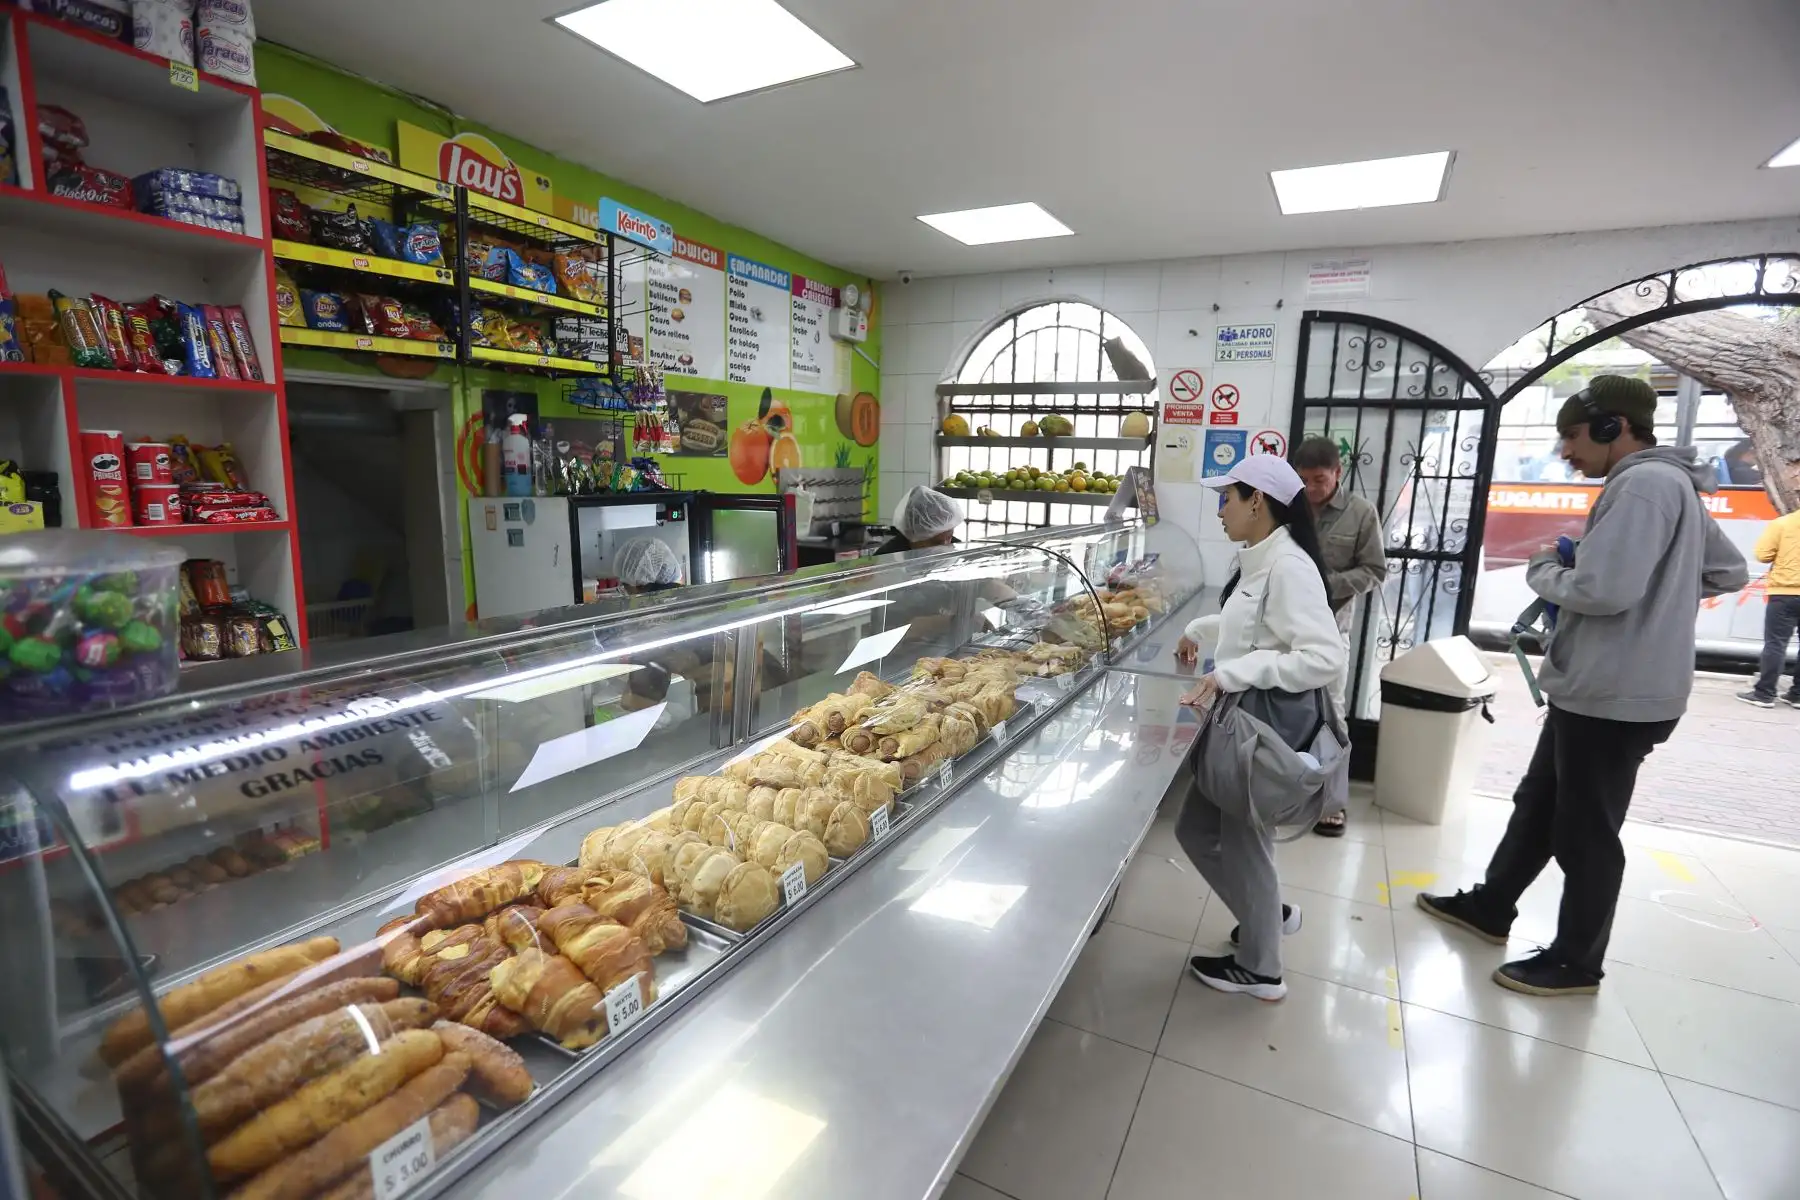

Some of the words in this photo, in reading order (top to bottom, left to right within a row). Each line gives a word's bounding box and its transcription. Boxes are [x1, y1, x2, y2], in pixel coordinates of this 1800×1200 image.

[202, 41, 250, 66] Paracas
[448, 145, 518, 201] Lay's
[616, 209, 658, 242] Karinto
[730, 257, 788, 288] EMPANADAS
[729, 275, 748, 287] Carne
[729, 288, 746, 299] Pollo
[729, 312, 749, 324] Queso
[649, 326, 667, 337] Papa
[729, 325, 758, 337] Enrollado
[1239, 327, 1273, 339] AFORO
[729, 337, 738, 346] de
[1220, 350, 1232, 359] 24
[1236, 349, 1272, 359] PERSONAS
[729, 373, 747, 383] Pizza
[93, 470, 123, 481] PRINGLES
[167, 746, 288, 789] MEDIO
[299, 706, 443, 754] AMBIENTE
[239, 748, 385, 800] GRACIAS
[622, 998, 640, 1020] 5.00
[400, 1151, 428, 1182] 3.00
